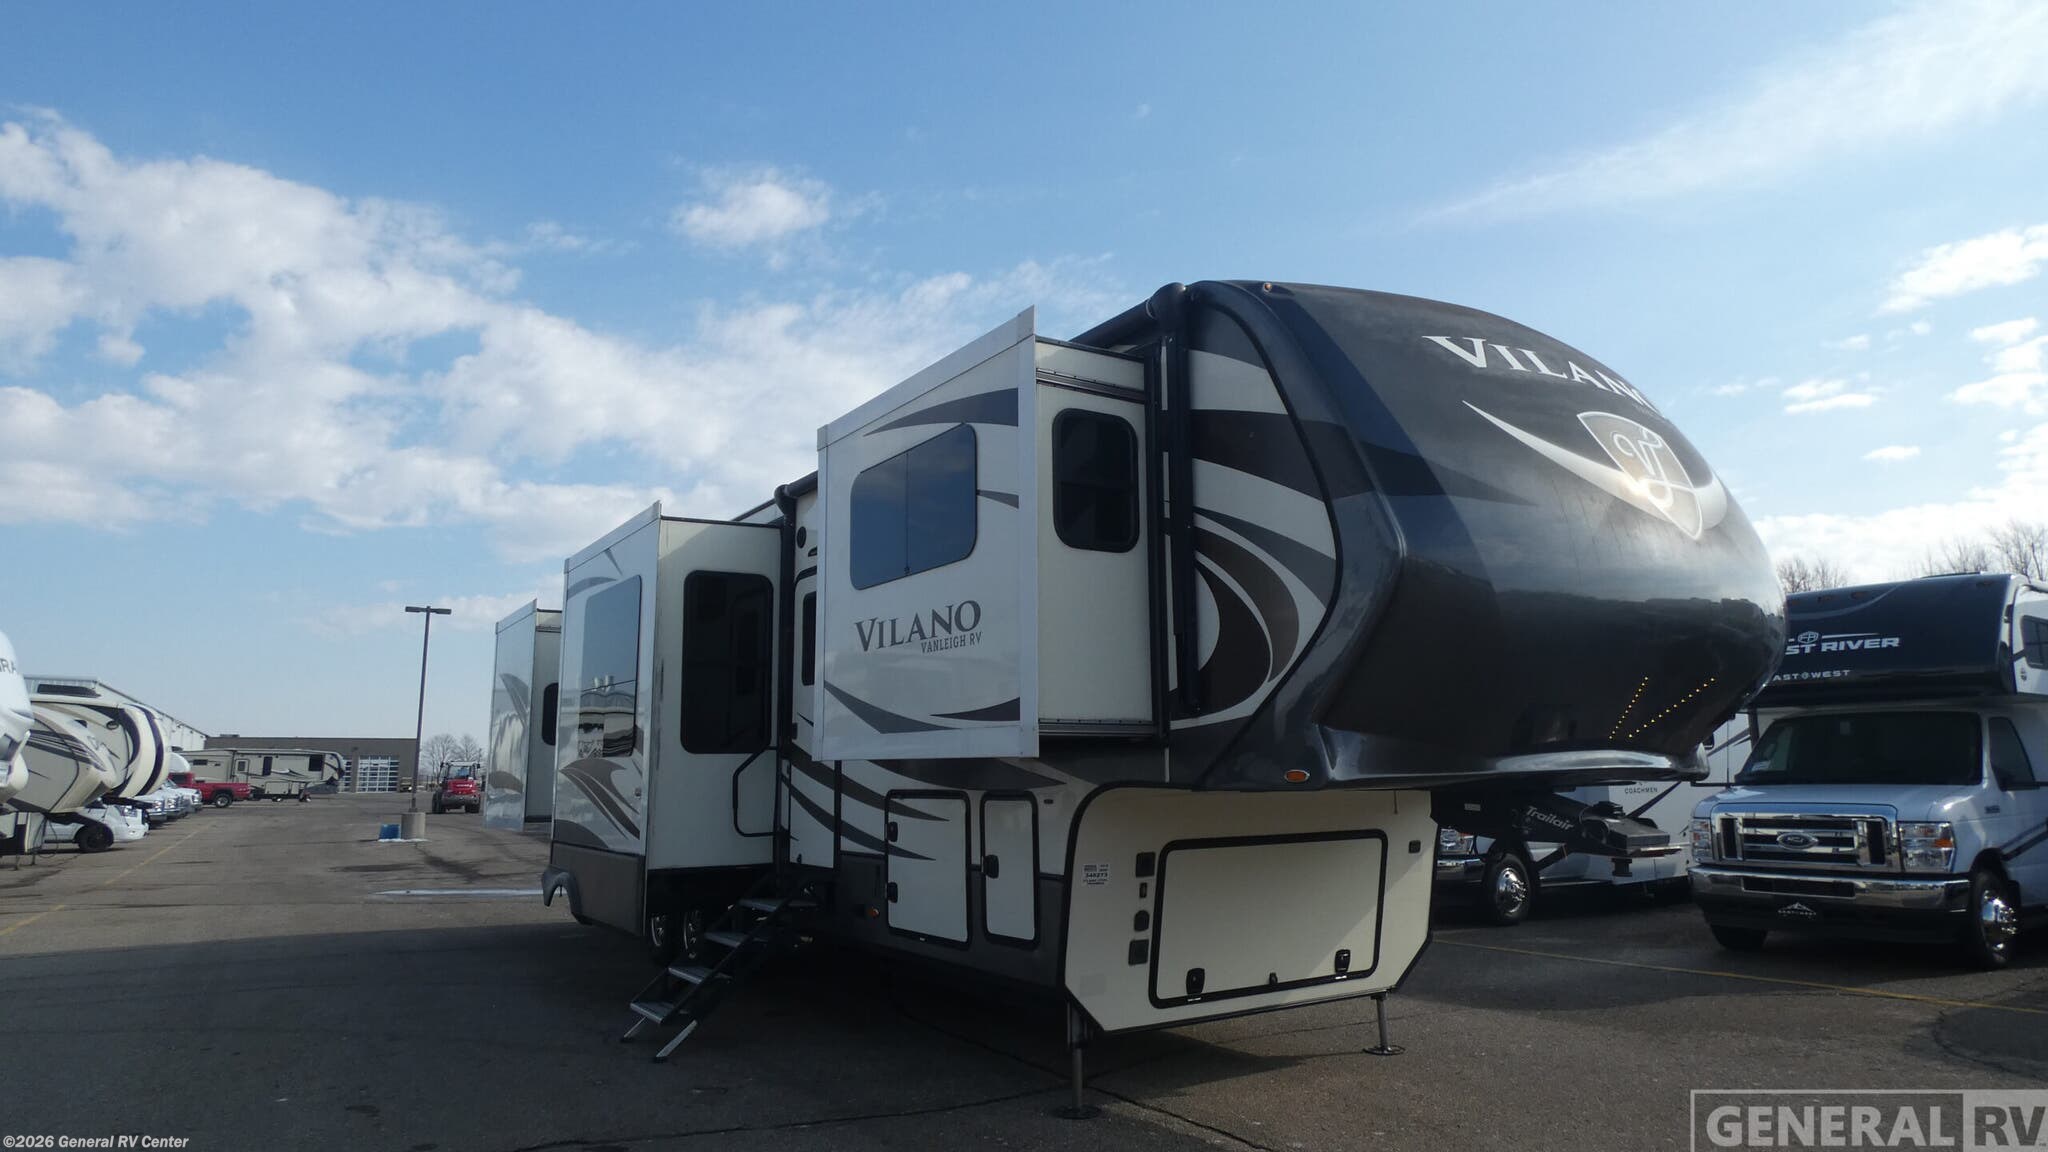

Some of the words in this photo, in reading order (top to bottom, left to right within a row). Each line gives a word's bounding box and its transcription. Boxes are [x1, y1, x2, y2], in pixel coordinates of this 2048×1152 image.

[854, 600, 982, 652] VILANO
[920, 635, 966, 653] VANLEIGH
[969, 631, 982, 645] RV
[1784, 644, 1816, 655] ST
[1821, 637, 1900, 652] RIVER
[1772, 673, 1800, 682] AST
[1810, 669, 1851, 679] WEST
[1525, 806, 1576, 831] Trailair
